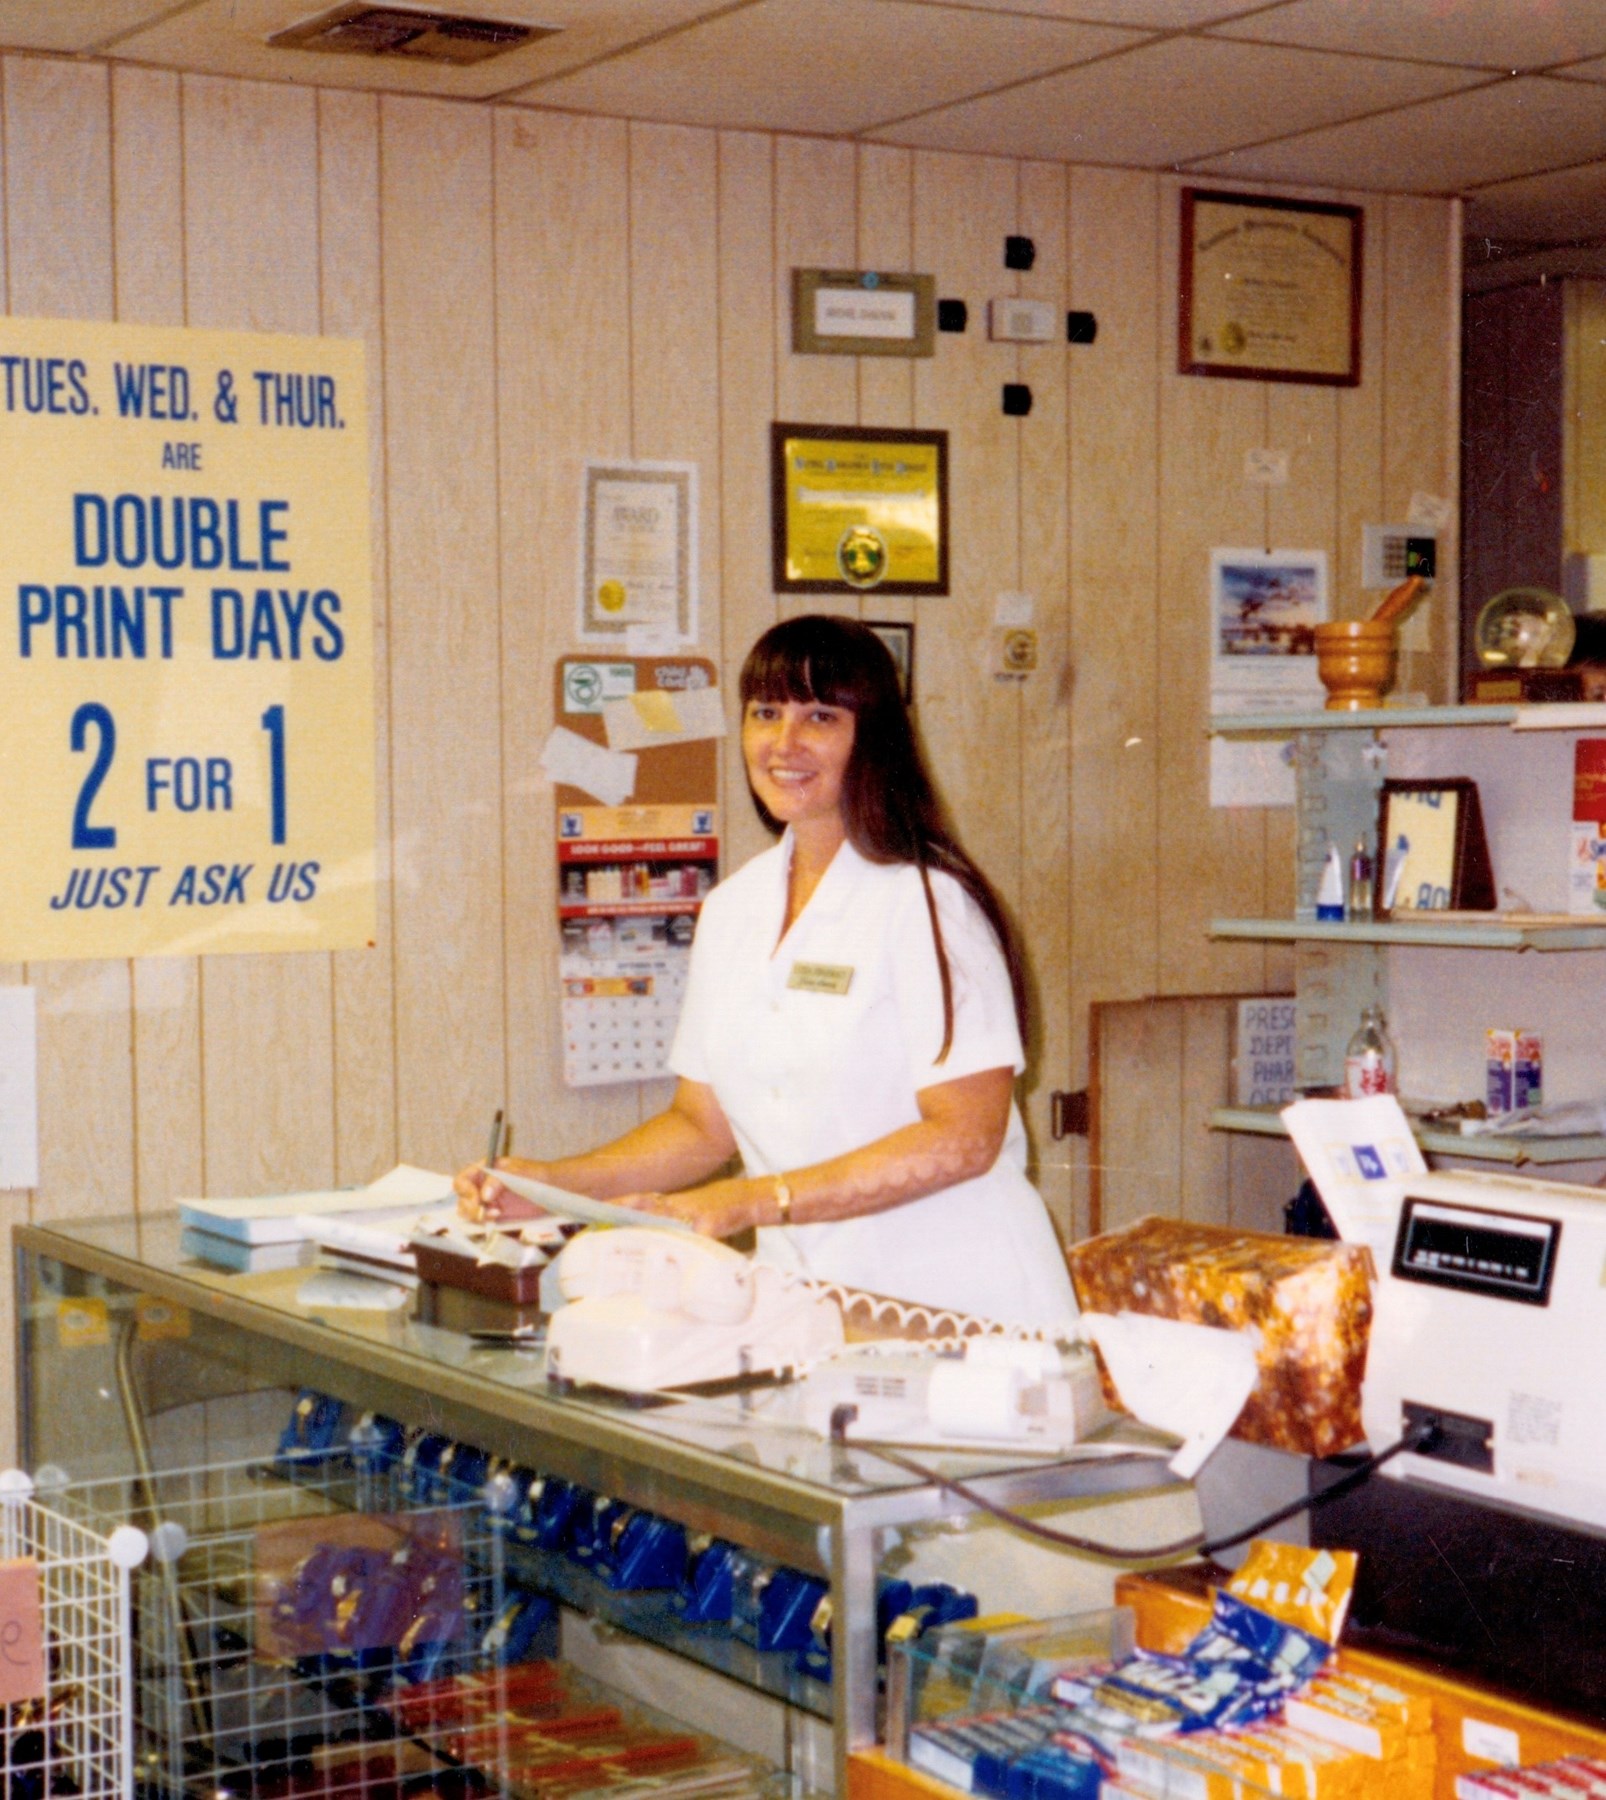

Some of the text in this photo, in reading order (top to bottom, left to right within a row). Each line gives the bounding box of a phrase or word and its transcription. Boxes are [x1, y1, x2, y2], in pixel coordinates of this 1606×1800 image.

[0, 355, 345, 429] TUES. WED. & THUR.
[162, 442, 202, 471] ARE
[73, 492, 291, 573] DOUBLE
[17, 583, 345, 662] PRINT DAYS
[69, 702, 287, 850] 2 FOR 1
[50, 861, 320, 910] JUST ASK US
